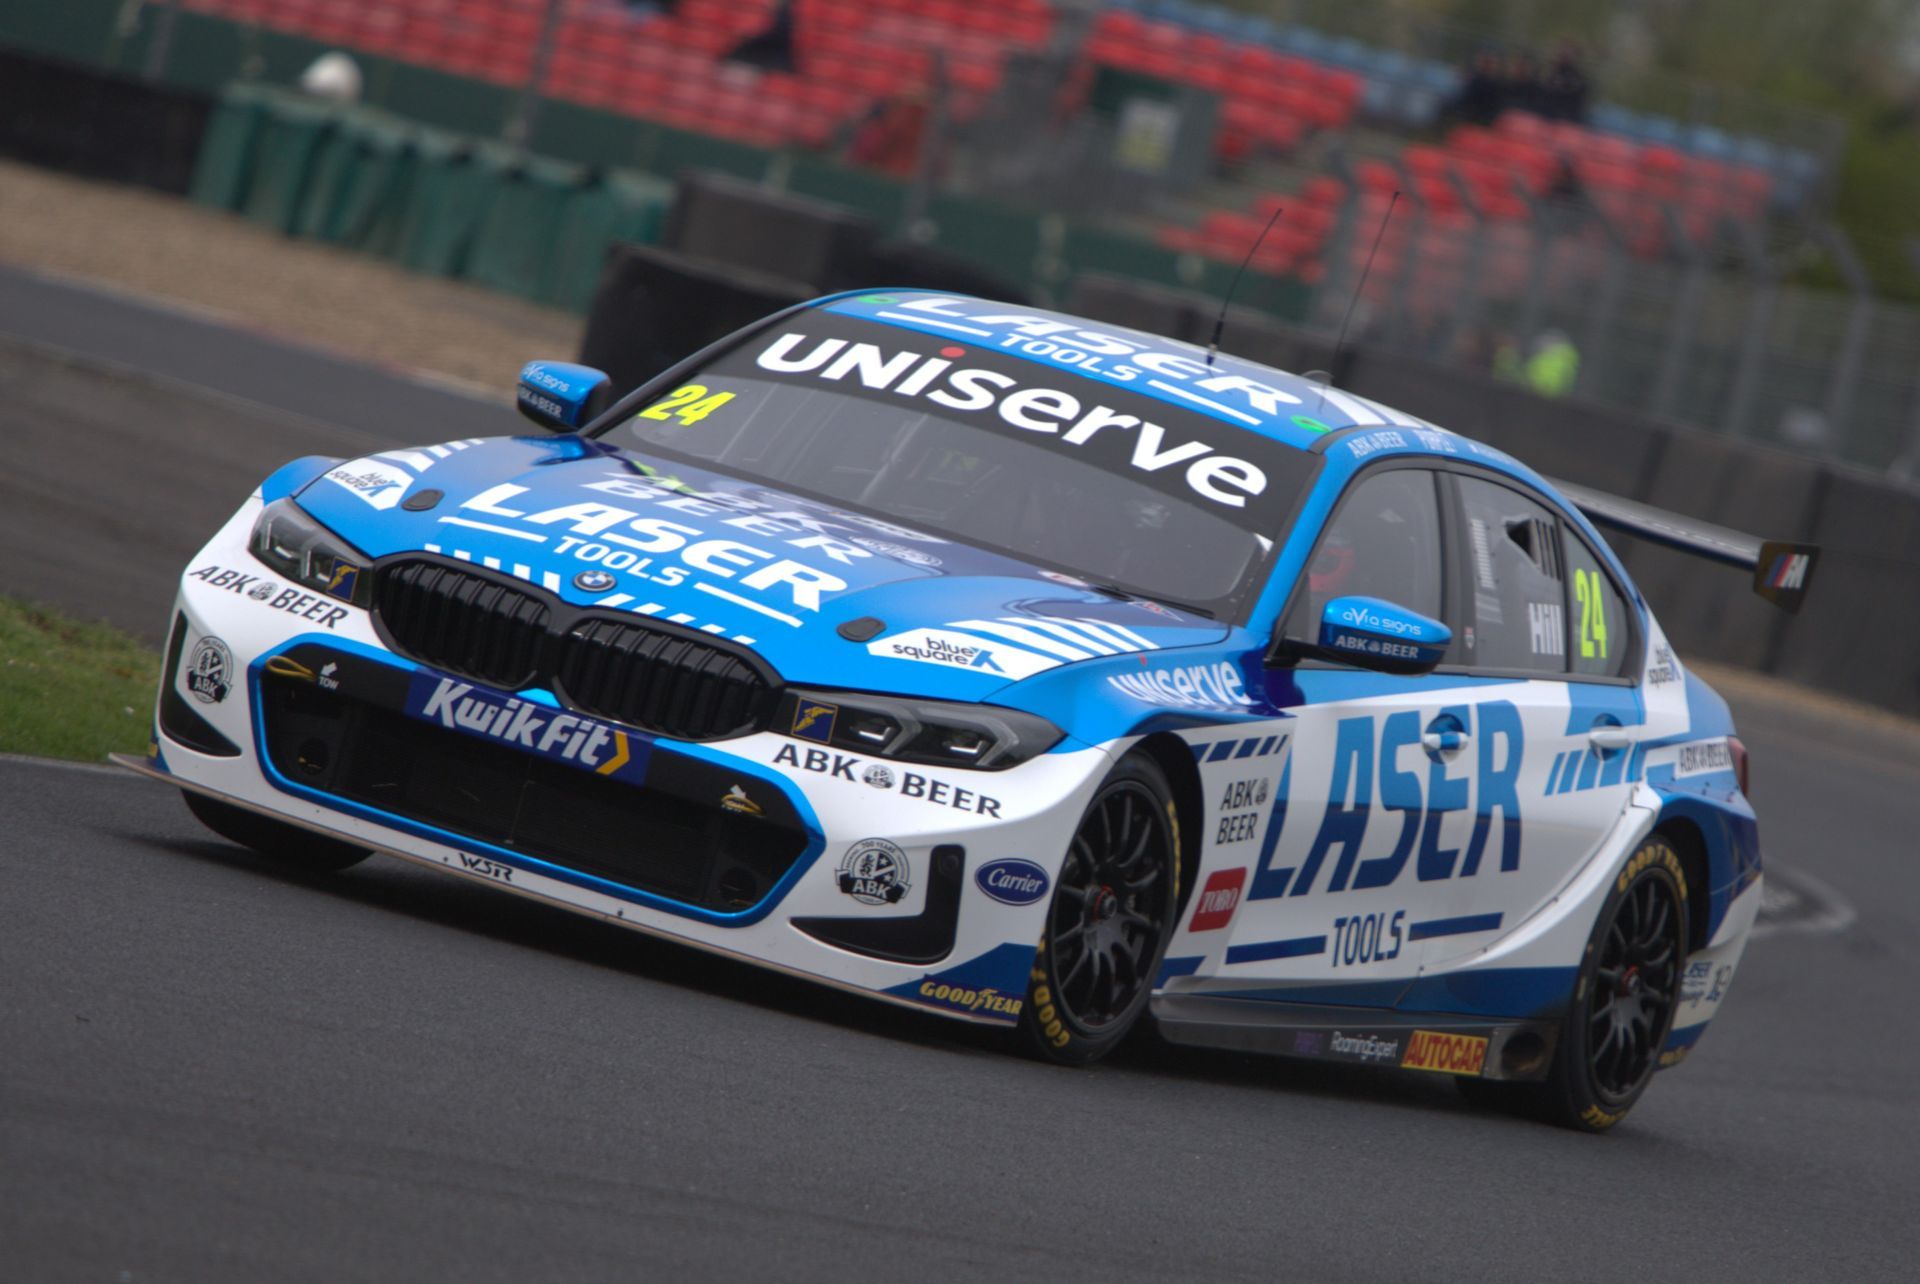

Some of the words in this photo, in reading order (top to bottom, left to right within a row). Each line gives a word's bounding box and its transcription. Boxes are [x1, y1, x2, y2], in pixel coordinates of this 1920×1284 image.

[897, 299, 1303, 416] LASER
[1000, 333, 1144, 381] TOOLS
[639, 384, 737, 426] 24
[578, 479, 874, 566] BEER
[460, 482, 848, 612] LASER
[554, 536, 691, 586] TOOLS
[189, 566, 260, 594] ABK
[268, 588, 349, 629] BEER
[1575, 568, 1608, 659] 24
[926, 637, 976, 655] blue
[1334, 634, 1370, 651] ABK
[1381, 643, 1419, 659] BEER
[1529, 602, 1564, 656] Hill
[893, 643, 968, 666] square
[194, 676, 219, 697] ABK
[318, 676, 340, 690] TOW
[773, 743, 861, 782] ABK
[900, 772, 1002, 819] BEER
[1220, 778, 1258, 811] ABK
[1246, 699, 1525, 901] LASER
[1216, 812, 1259, 845] BEER
[459, 853, 513, 882] WSR
[987, 868, 1044, 893] Carrier
[852, 879, 890, 900] ABK
[1333, 910, 1407, 967] TOOLS
[920, 981, 1023, 1015] GOODYEAR
[1402, 1031, 1488, 1072] AUTOCAR
